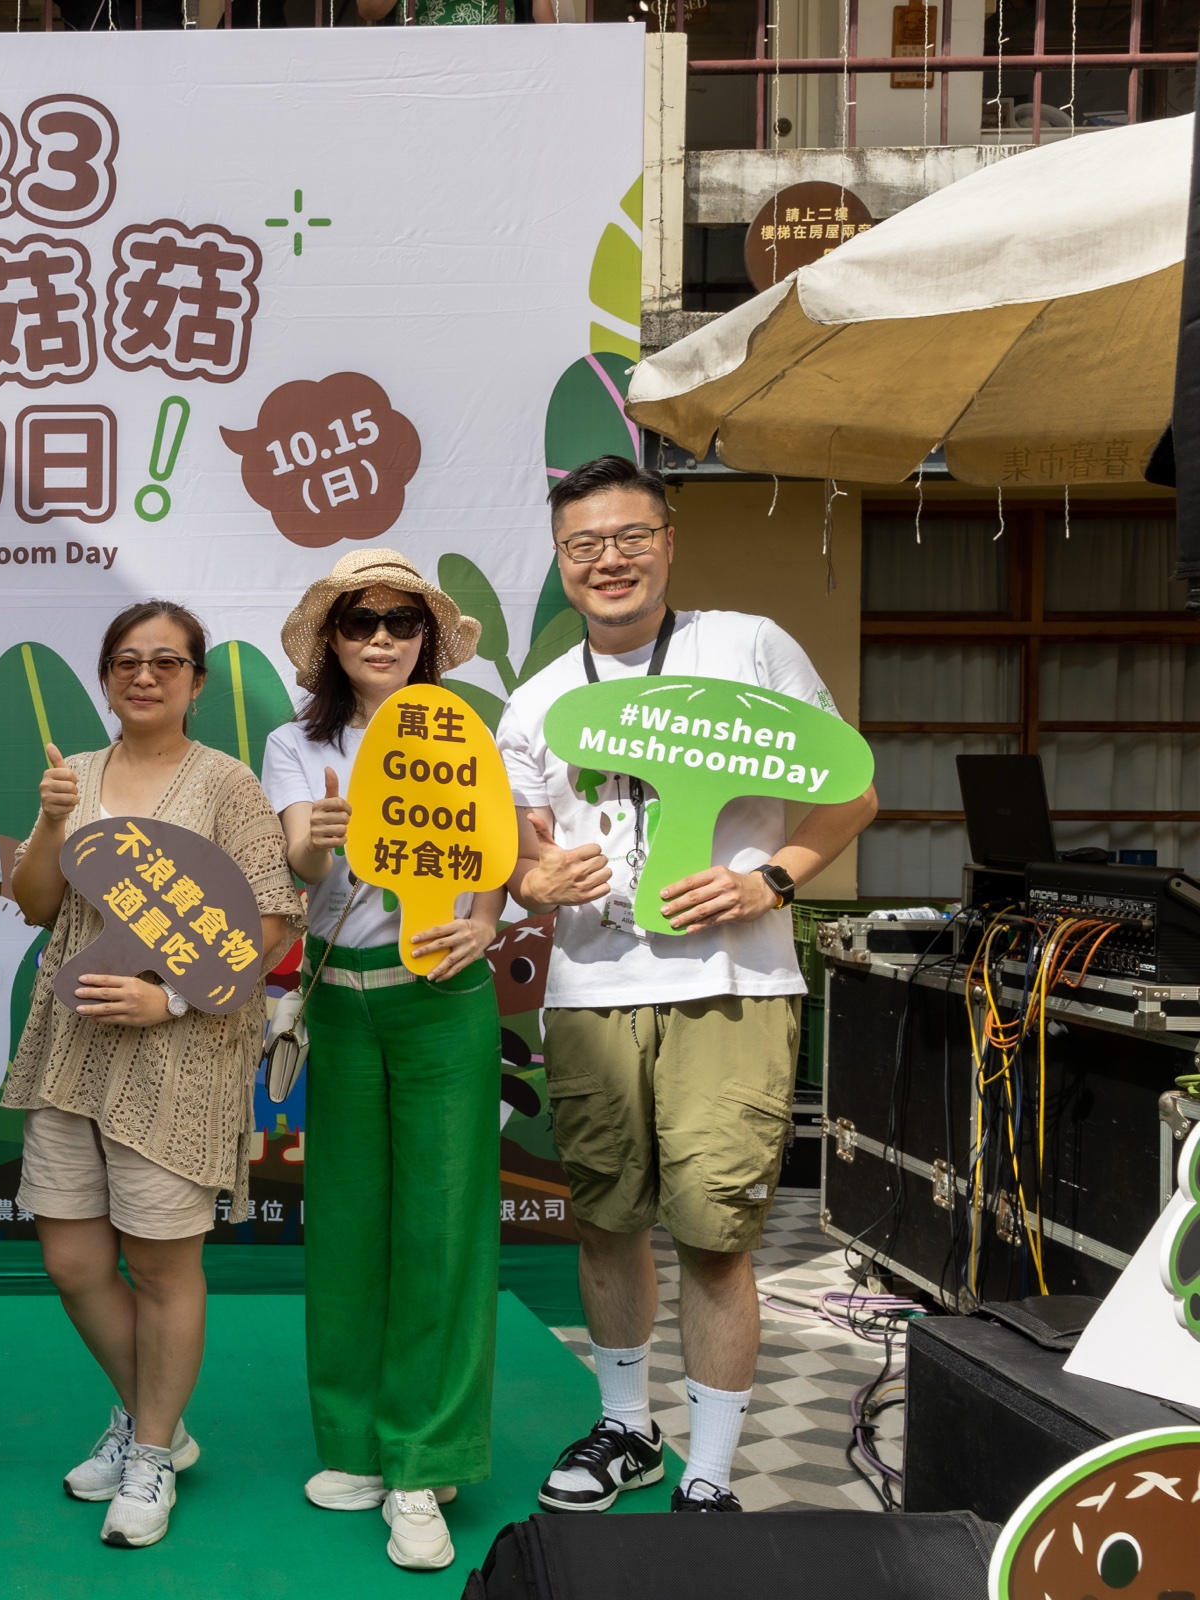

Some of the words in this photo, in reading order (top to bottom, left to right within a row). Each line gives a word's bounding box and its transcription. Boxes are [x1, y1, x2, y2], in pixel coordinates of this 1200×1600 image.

[785, 206, 849, 223] 請上二樓
[266, 408, 380, 476] 10.15
[66, 541, 119, 570] Day
[397, 702, 467, 743] 萬生
[619, 703, 797, 751] #Wanshen
[382, 749, 477, 787] Good
[579, 727, 830, 793] MushroomDay
[381, 795, 476, 832] Good
[374, 836, 483, 882] 好食物
[114, 821, 259, 972] 不浪費食物
[102, 877, 200, 976] 適量吃
